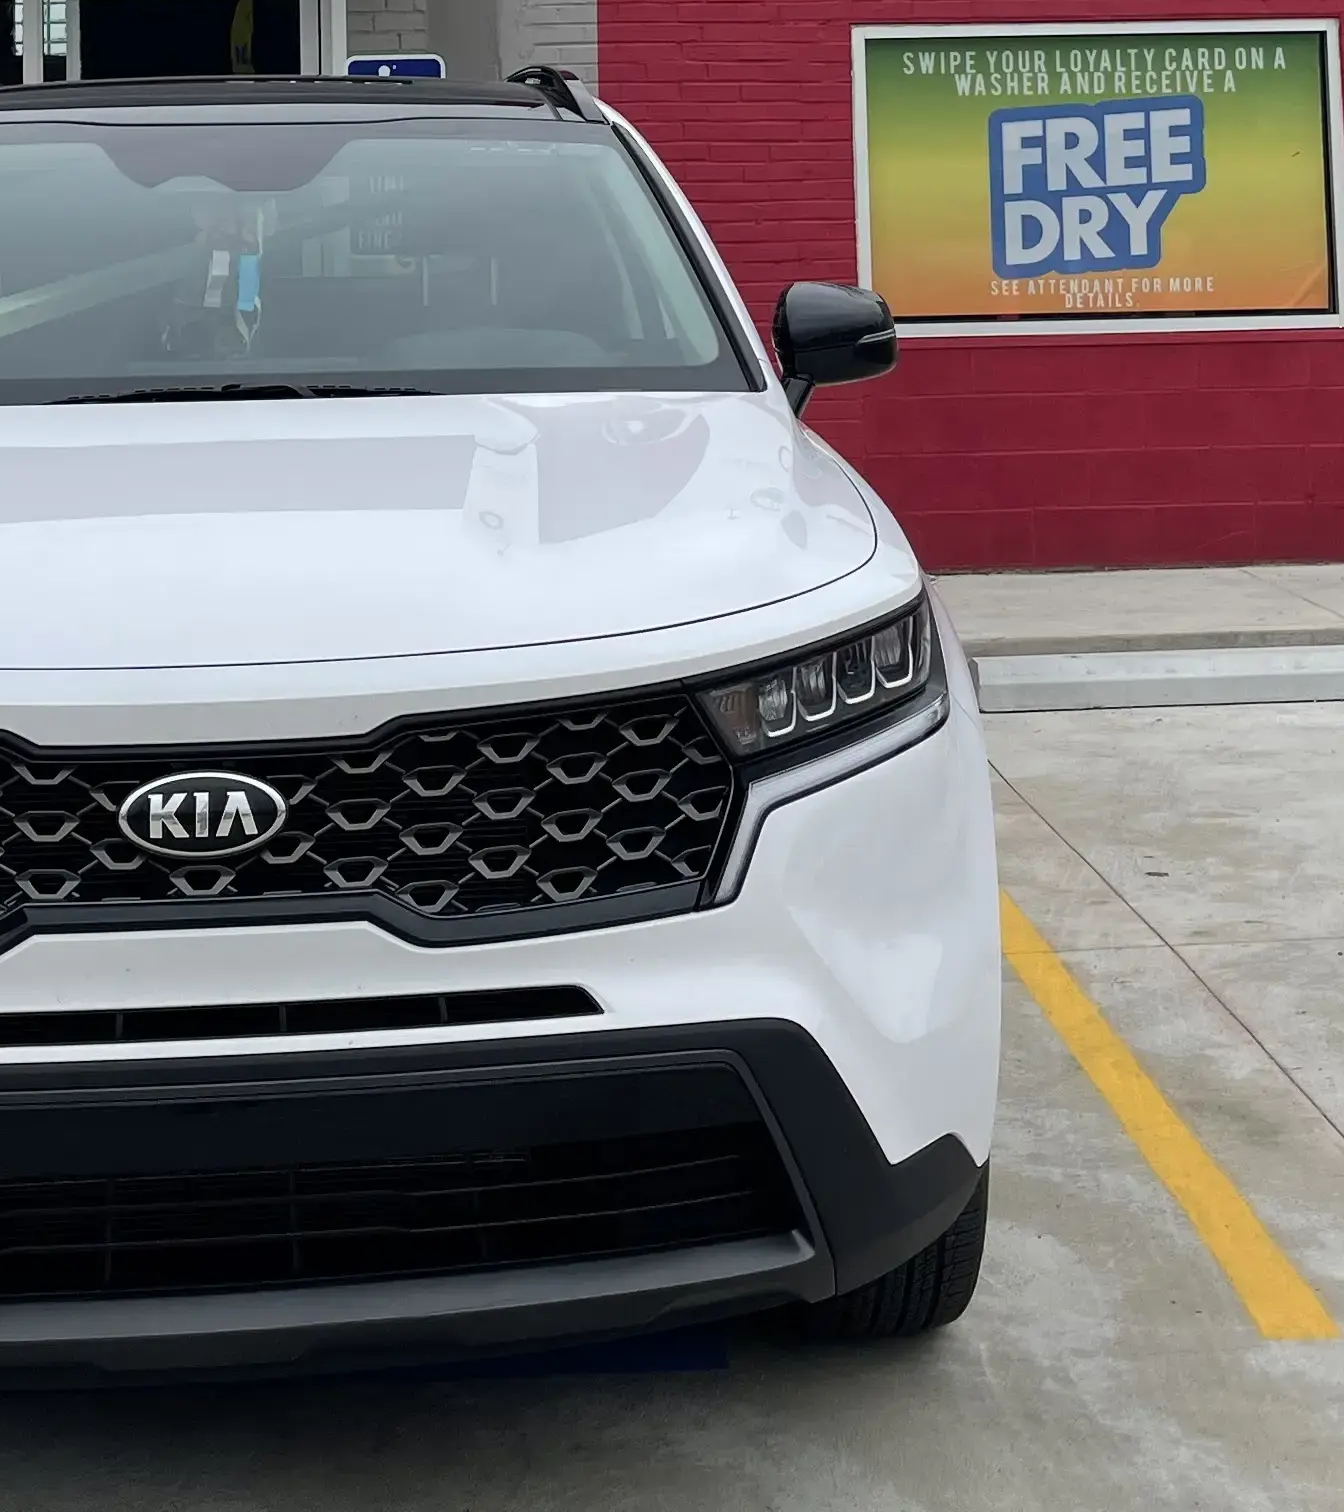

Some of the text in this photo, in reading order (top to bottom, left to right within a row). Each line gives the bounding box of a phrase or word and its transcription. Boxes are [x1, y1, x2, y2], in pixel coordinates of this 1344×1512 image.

[902, 46, 1287, 75] SWIPE YOUR LOYALTY CARD ON A
[954, 69, 1237, 96] WASHER AND RECEIVE A
[1001, 107, 1193, 195] FREE
[1003, 189, 1168, 266] DRY
[990, 276, 1215, 296] SEE ATTENDANT FOR MORE
[147, 790, 259, 839] KIA
